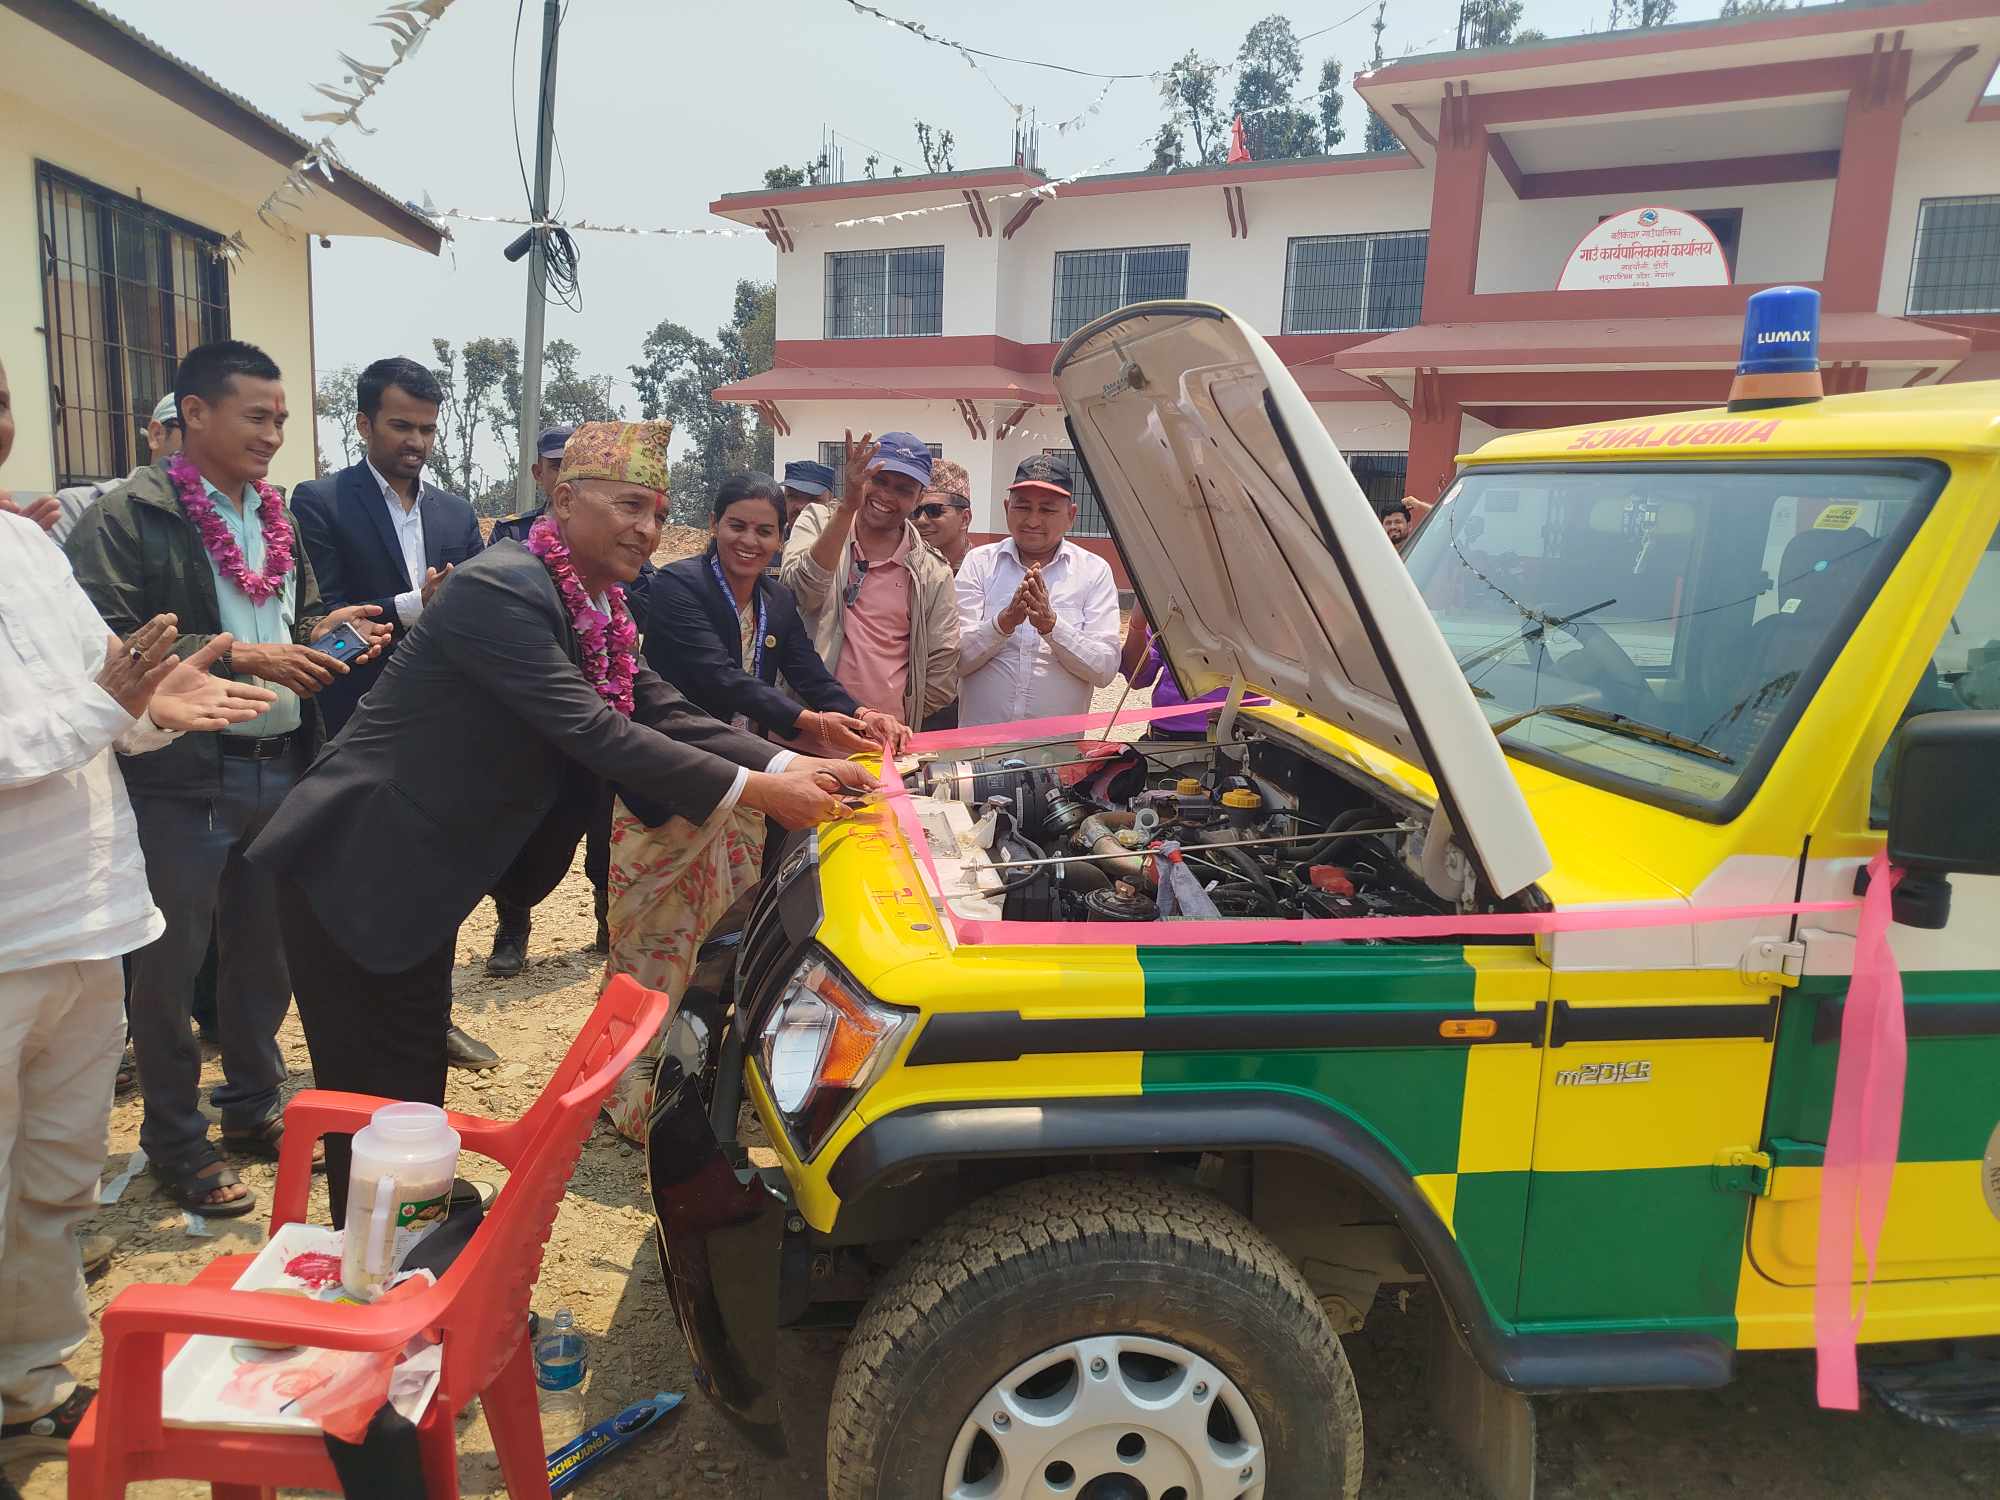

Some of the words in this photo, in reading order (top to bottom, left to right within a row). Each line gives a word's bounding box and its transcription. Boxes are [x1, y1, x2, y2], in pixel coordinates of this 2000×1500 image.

[1671, 238, 1714, 256] कार्यालय
[1757, 330, 1811, 344] LUMAX
[547, 1433, 611, 1482] NCHENJUNGA
